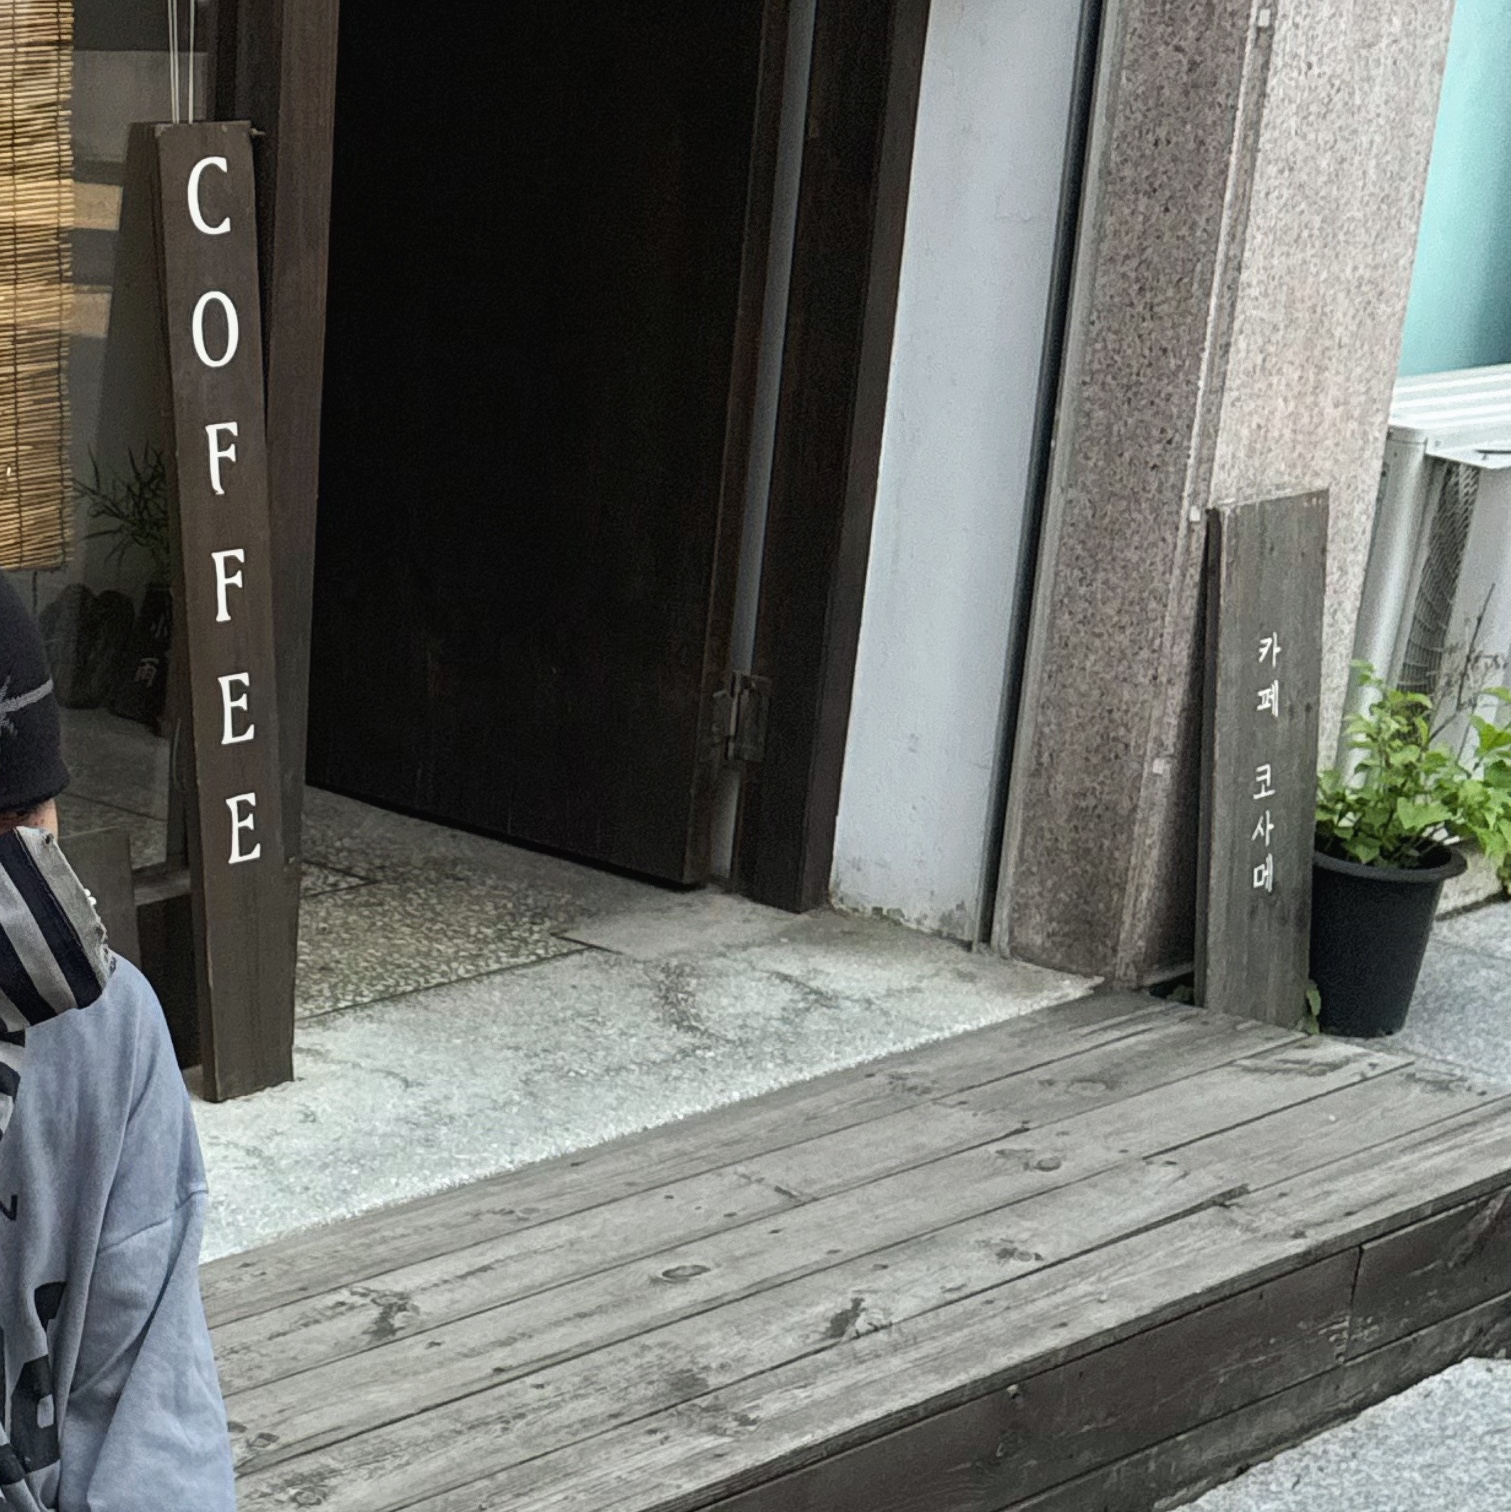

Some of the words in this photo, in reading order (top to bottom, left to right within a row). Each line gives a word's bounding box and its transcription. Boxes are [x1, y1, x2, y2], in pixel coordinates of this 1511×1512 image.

[187, 156, 261, 865] COFFEE
[1256, 631, 1282, 718] 카페
[1251, 763, 1276, 893] 코사메
